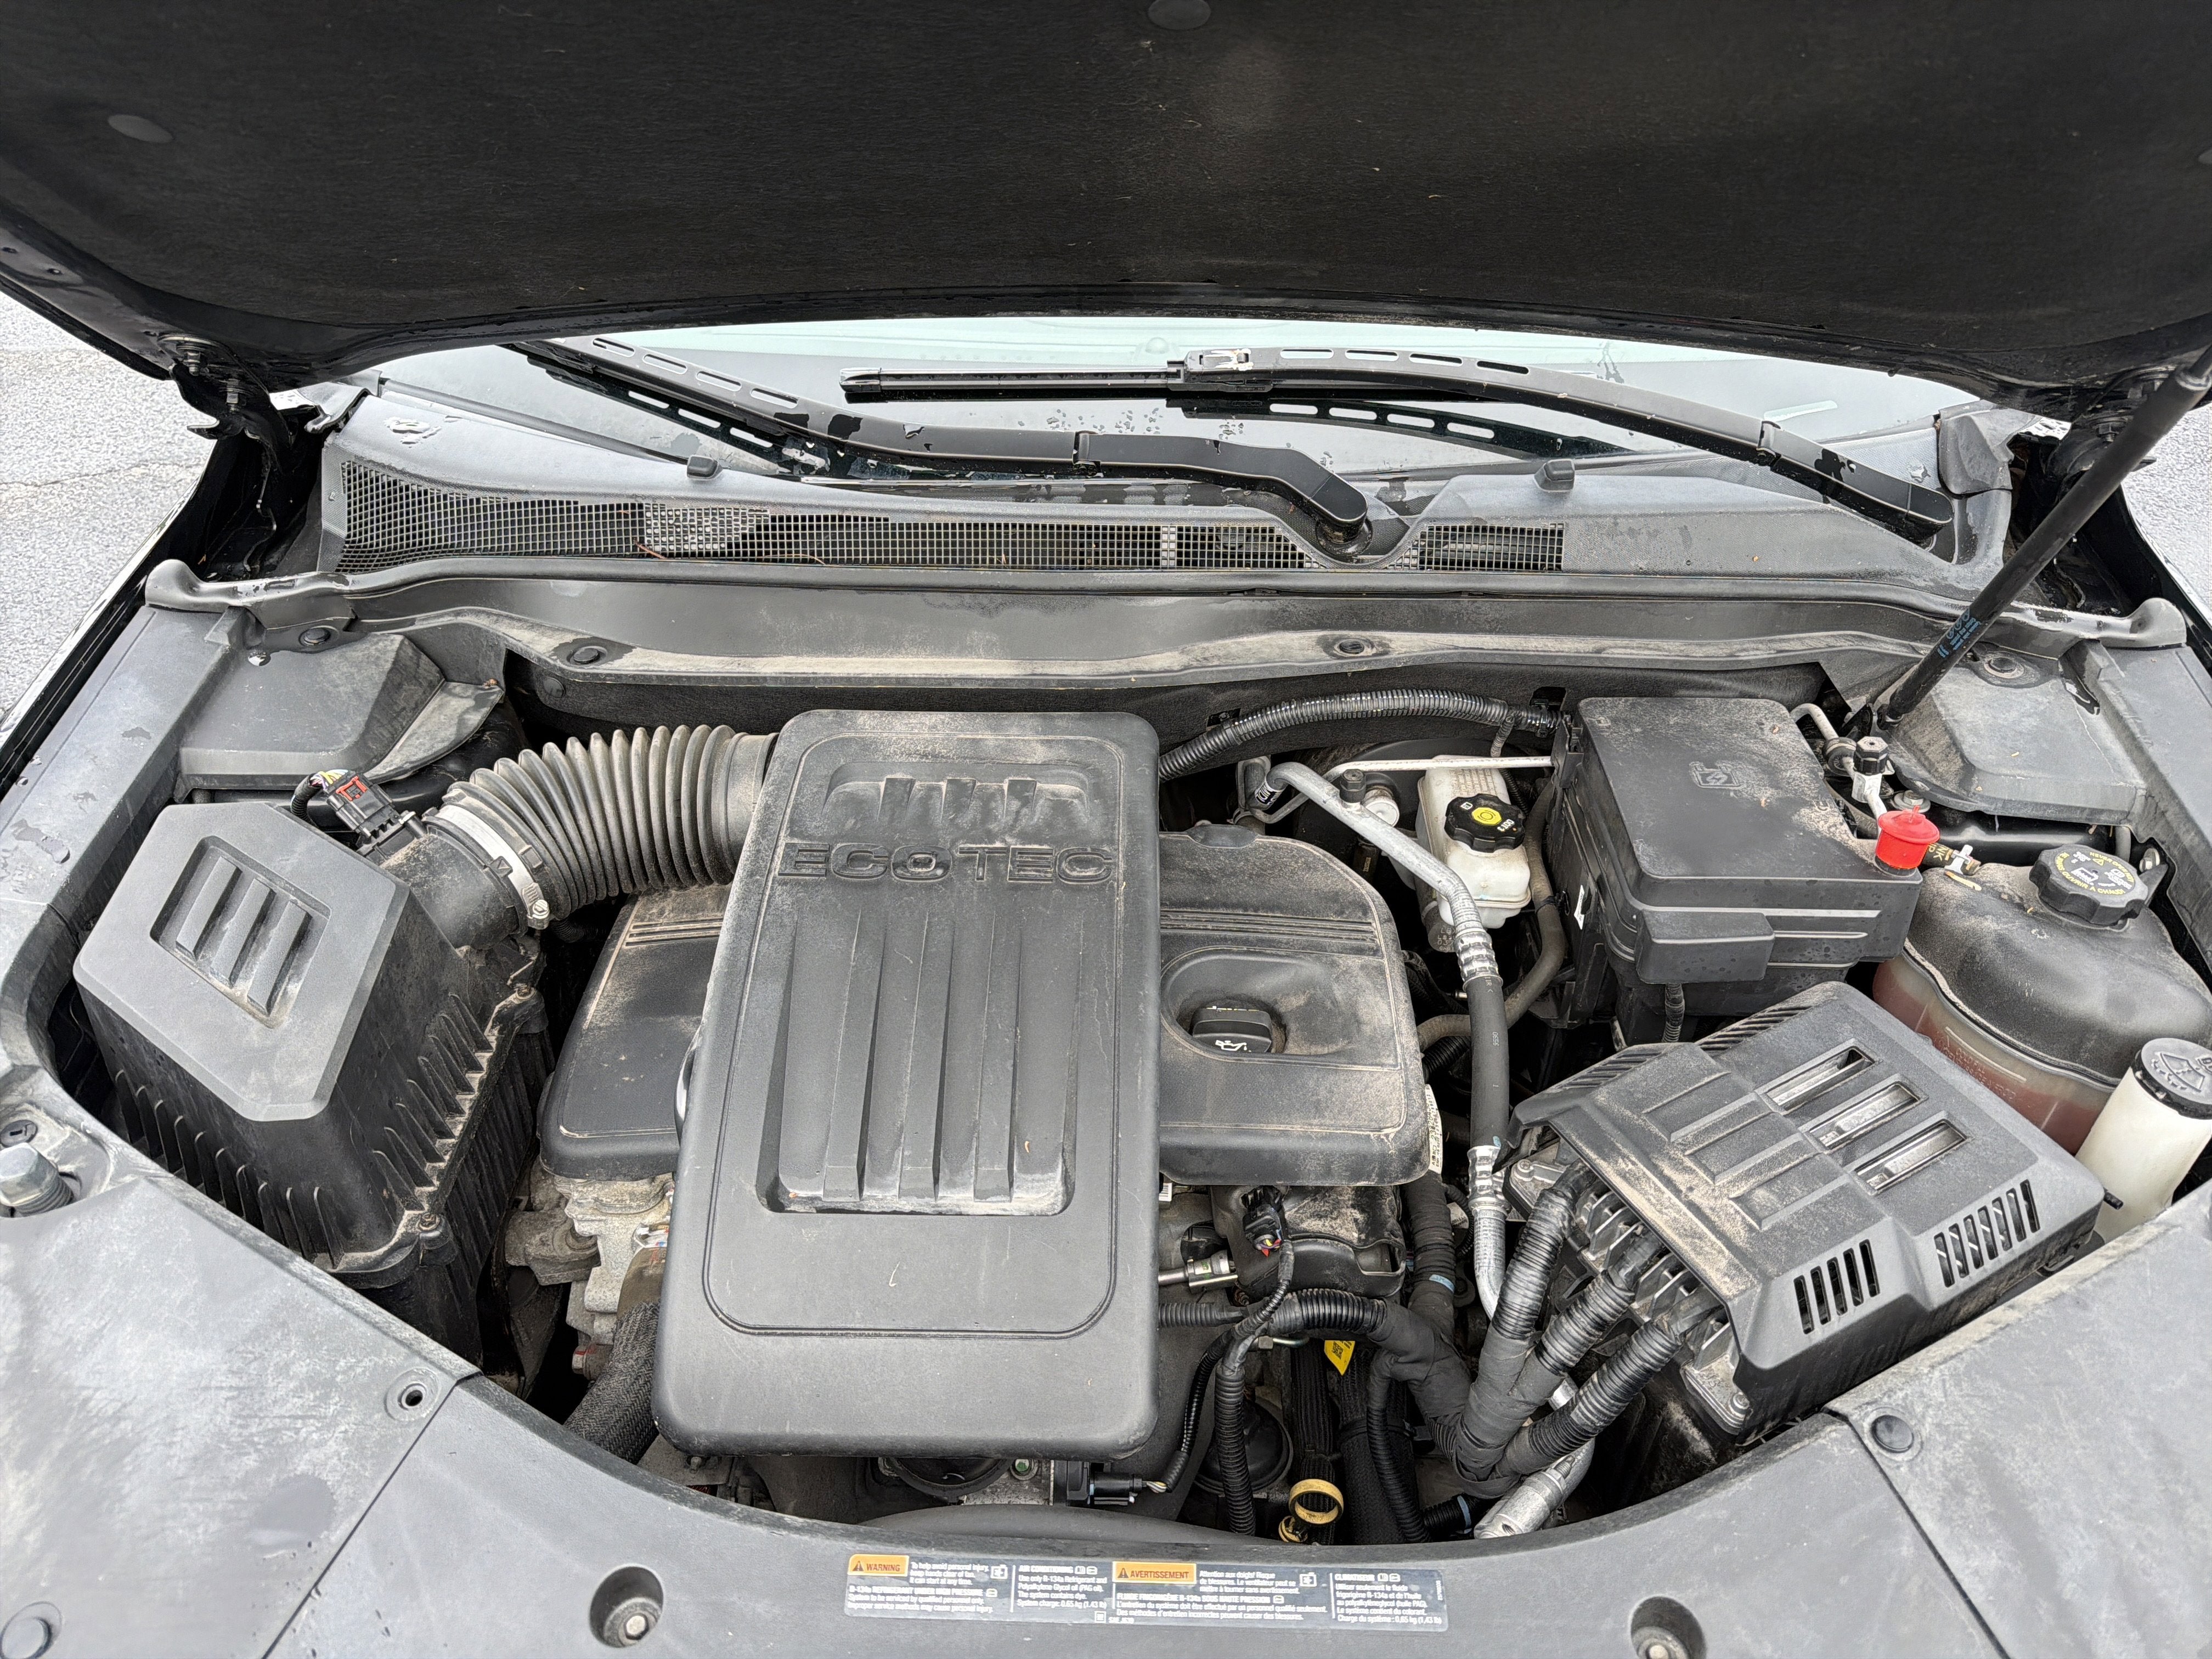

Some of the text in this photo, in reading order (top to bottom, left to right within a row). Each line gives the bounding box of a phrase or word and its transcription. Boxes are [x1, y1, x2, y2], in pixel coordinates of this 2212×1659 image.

[2090, 852, 2113, 862] NEVER
[777, 842, 1113, 885] ECOTEC
[2062, 871, 2089, 889] OUVRIR
[1956, 1048, 1973, 1064] COLD
[866, 1564, 900, 1572] WARNING
[1030, 1565, 1074, 1573] CONDITIONING
[1130, 1570, 1189, 1579] AVERTISSEMENT
[1064, 1576, 1096, 1584] Refrigerant
[951, 1588, 984, 1596] PRESSURE
[1018, 1583, 1053, 1591] Polyalkylene
[1053, 1583, 1070, 1592] Glycol
[848, 1593, 870, 1602] System
[918, 1595, 943, 1604] qualified
[971, 1597, 985, 1605] only.
[1240, 1595, 1271, 1604] PRESSION
[1335, 1591, 1366, 1600] frigorigène
[848, 1601, 873, 1610] Improper
[1017, 1599, 1039, 1607] System
[1074, 1600, 1083, 1609] kg
[1396, 1600, 1412, 1608] (huile
[1345, 1607, 1369, 1615] système
[1338, 1615, 1358, 1623] Charge
[1367, 1615, 1392, 1624] système
[1409, 1616, 1418, 1624] kg
[1433, 1616, 1443, 1624] lb)
